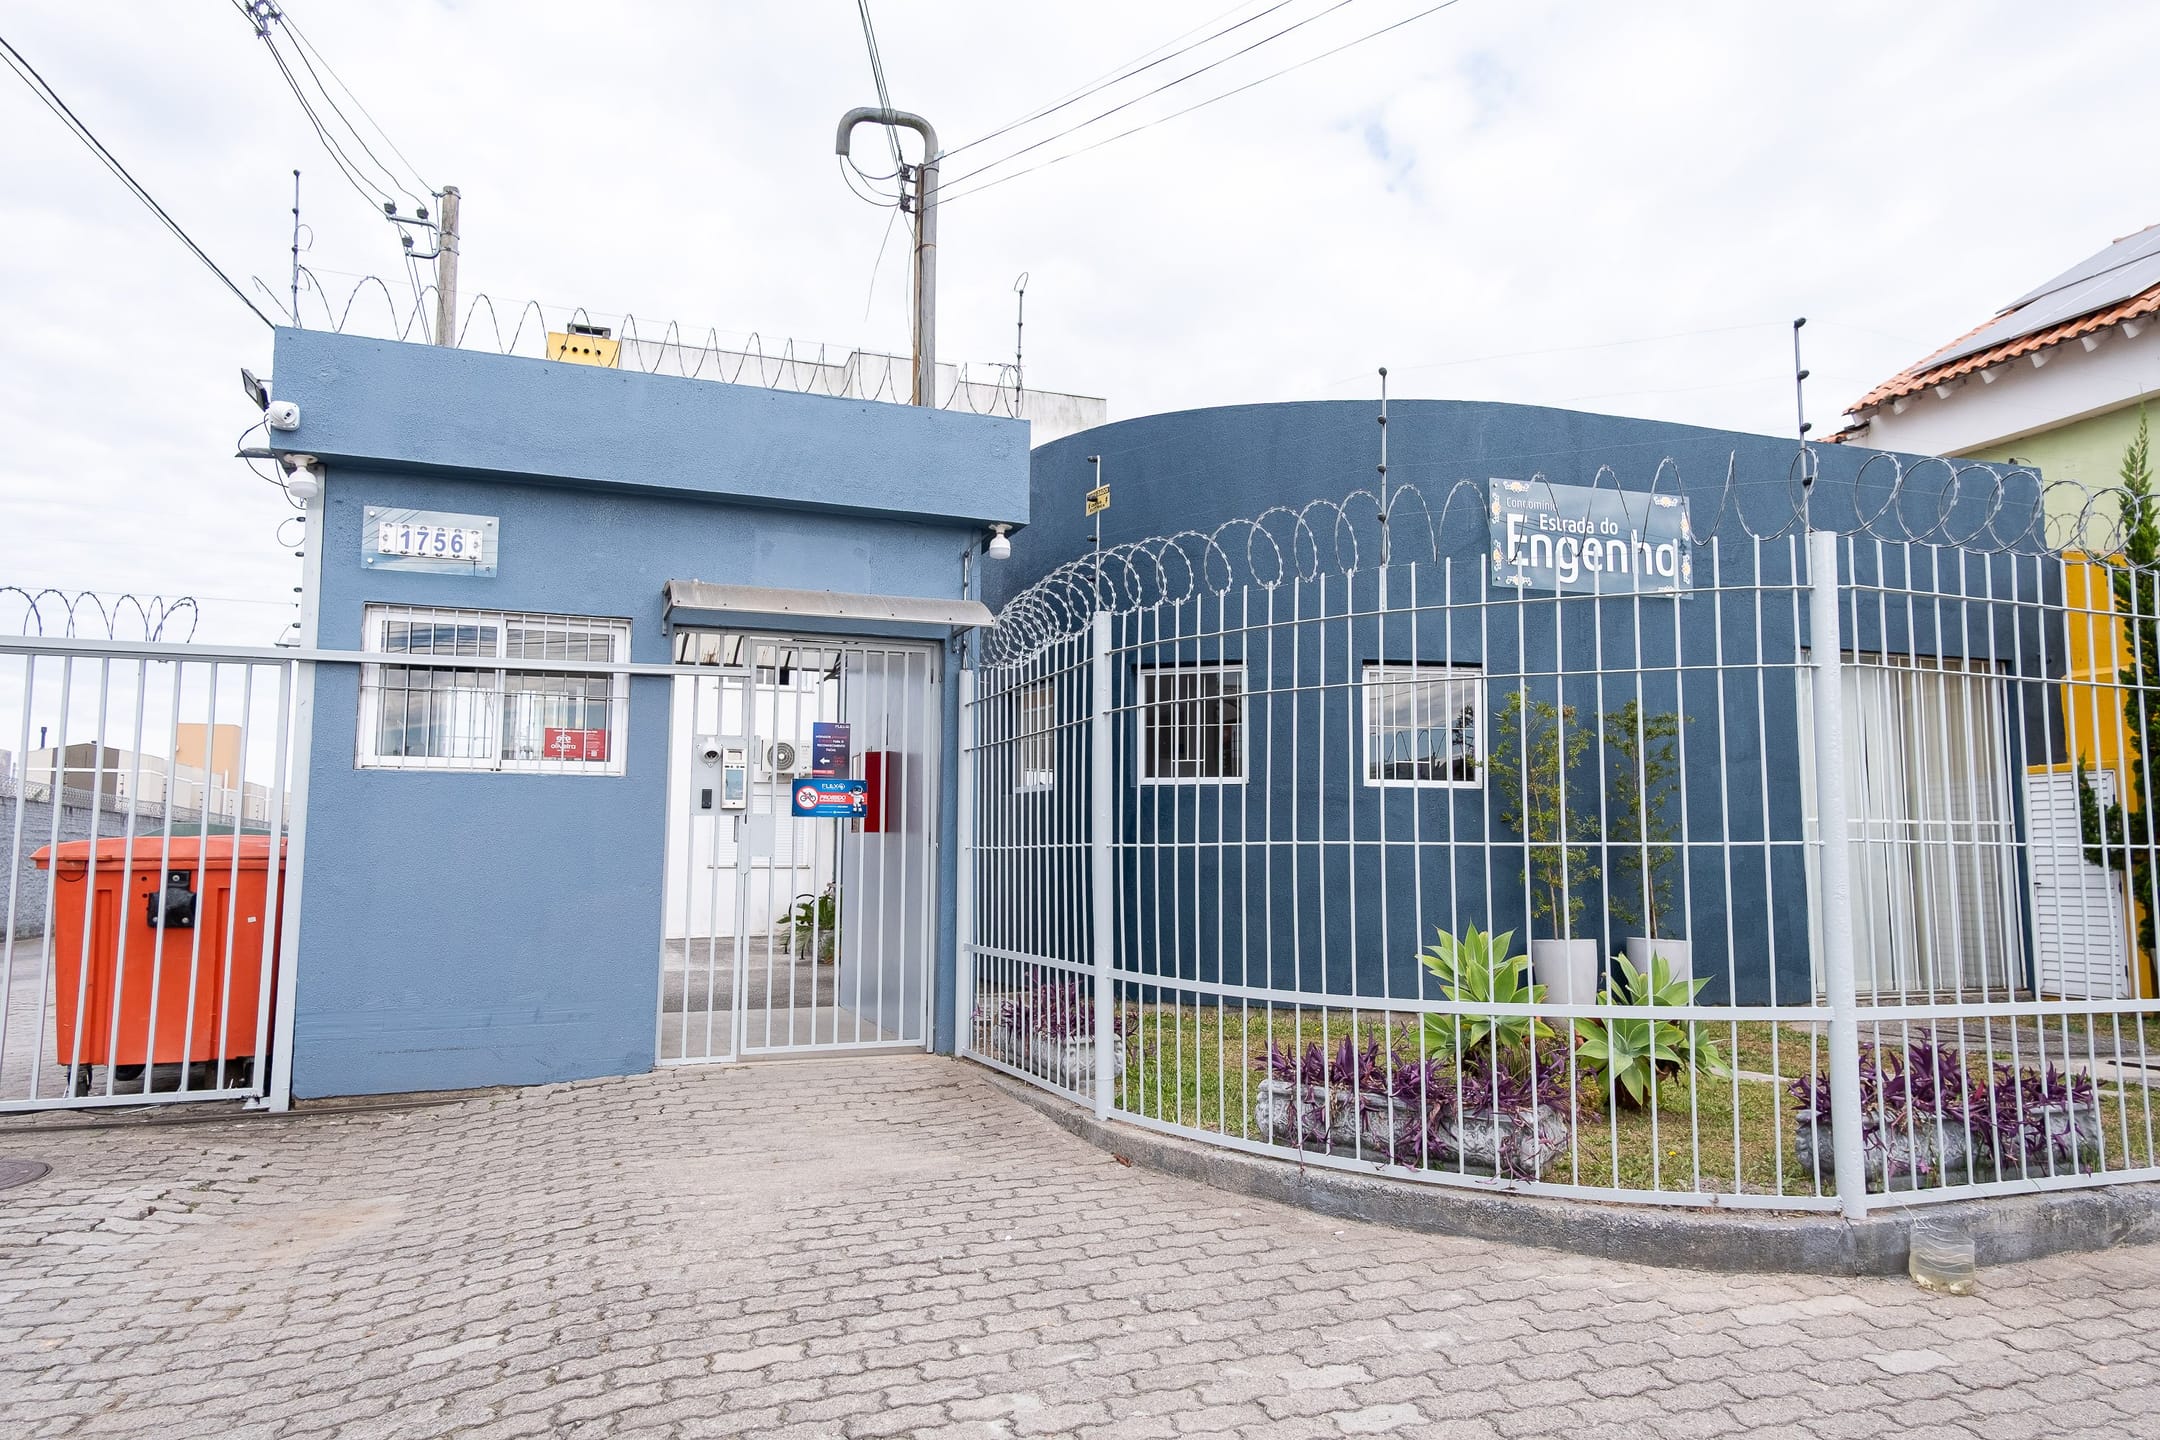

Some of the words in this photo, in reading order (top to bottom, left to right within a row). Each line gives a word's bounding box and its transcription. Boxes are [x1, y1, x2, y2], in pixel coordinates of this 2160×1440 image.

[1539, 513, 1595, 534] Estrada
[1600, 516, 1619, 535] do
[400, 530, 464, 554] 1756
[1506, 512, 1676, 584] Engenho
